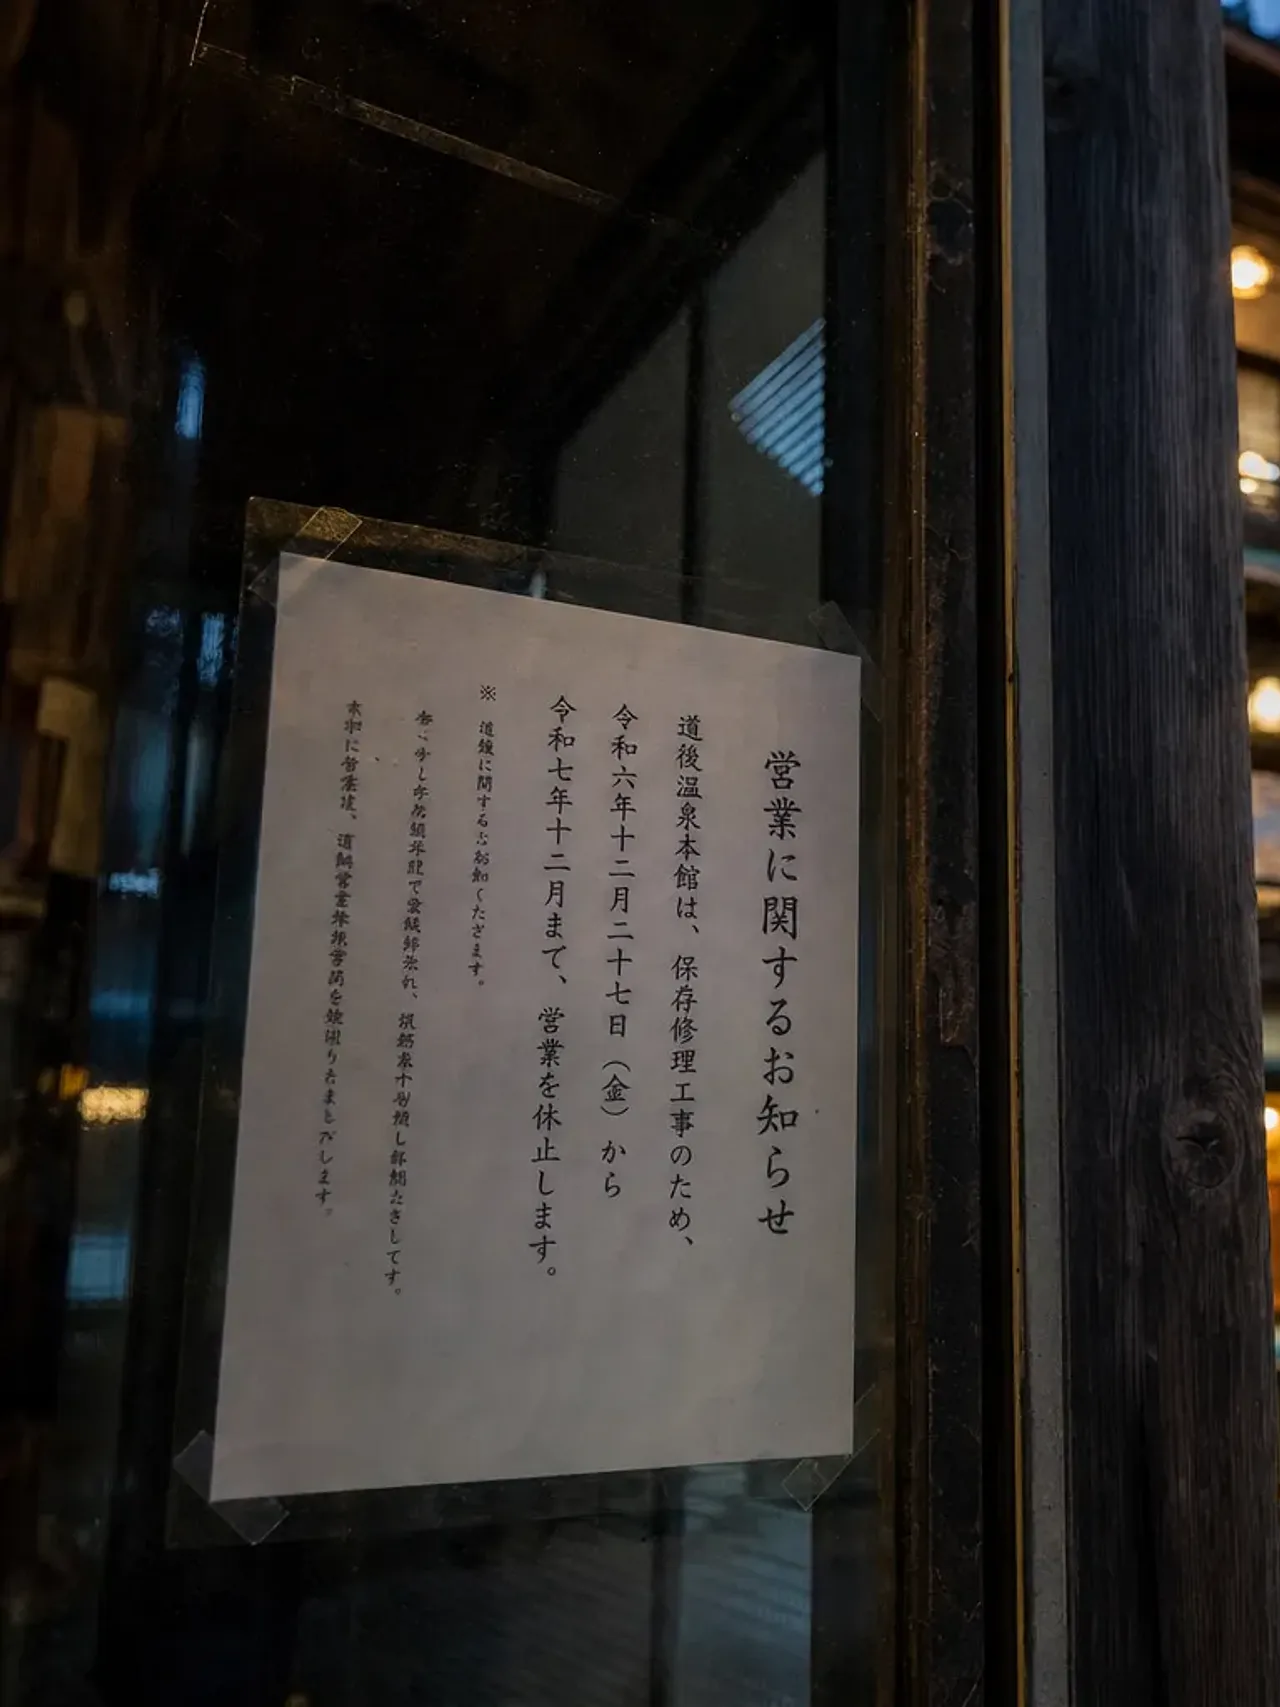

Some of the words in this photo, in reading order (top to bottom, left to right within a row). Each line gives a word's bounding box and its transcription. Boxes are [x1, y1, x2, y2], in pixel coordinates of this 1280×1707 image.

[756, 750, 802, 1235] 営業に関するお知らせ
